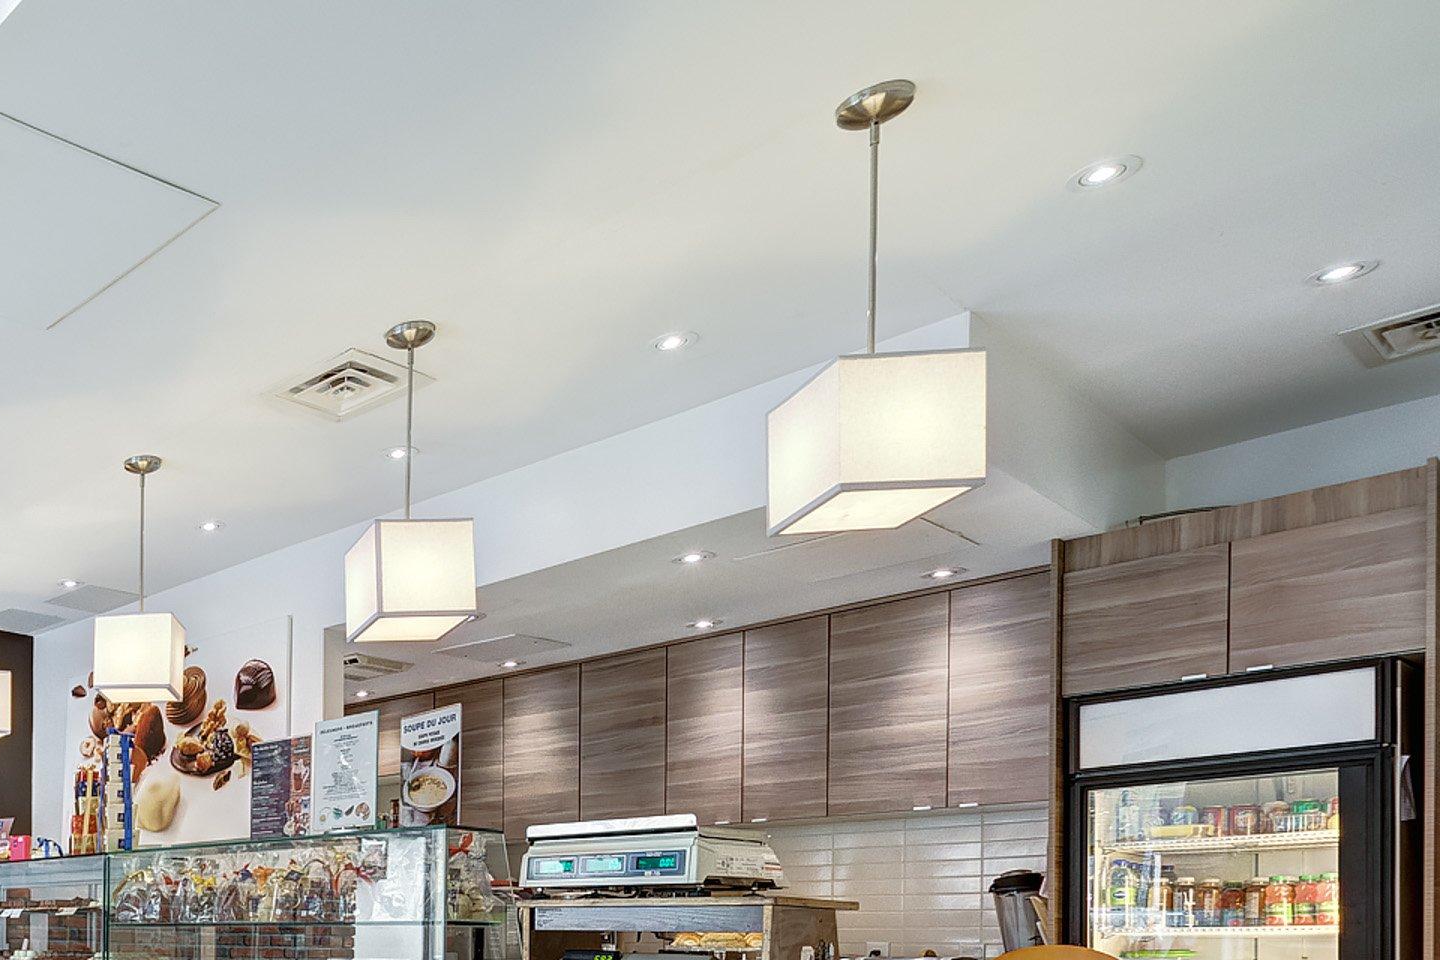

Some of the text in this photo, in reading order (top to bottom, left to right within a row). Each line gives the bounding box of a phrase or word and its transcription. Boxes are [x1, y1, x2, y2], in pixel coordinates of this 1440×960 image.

[404, 714, 456, 734] SOUPE DU JOUR
